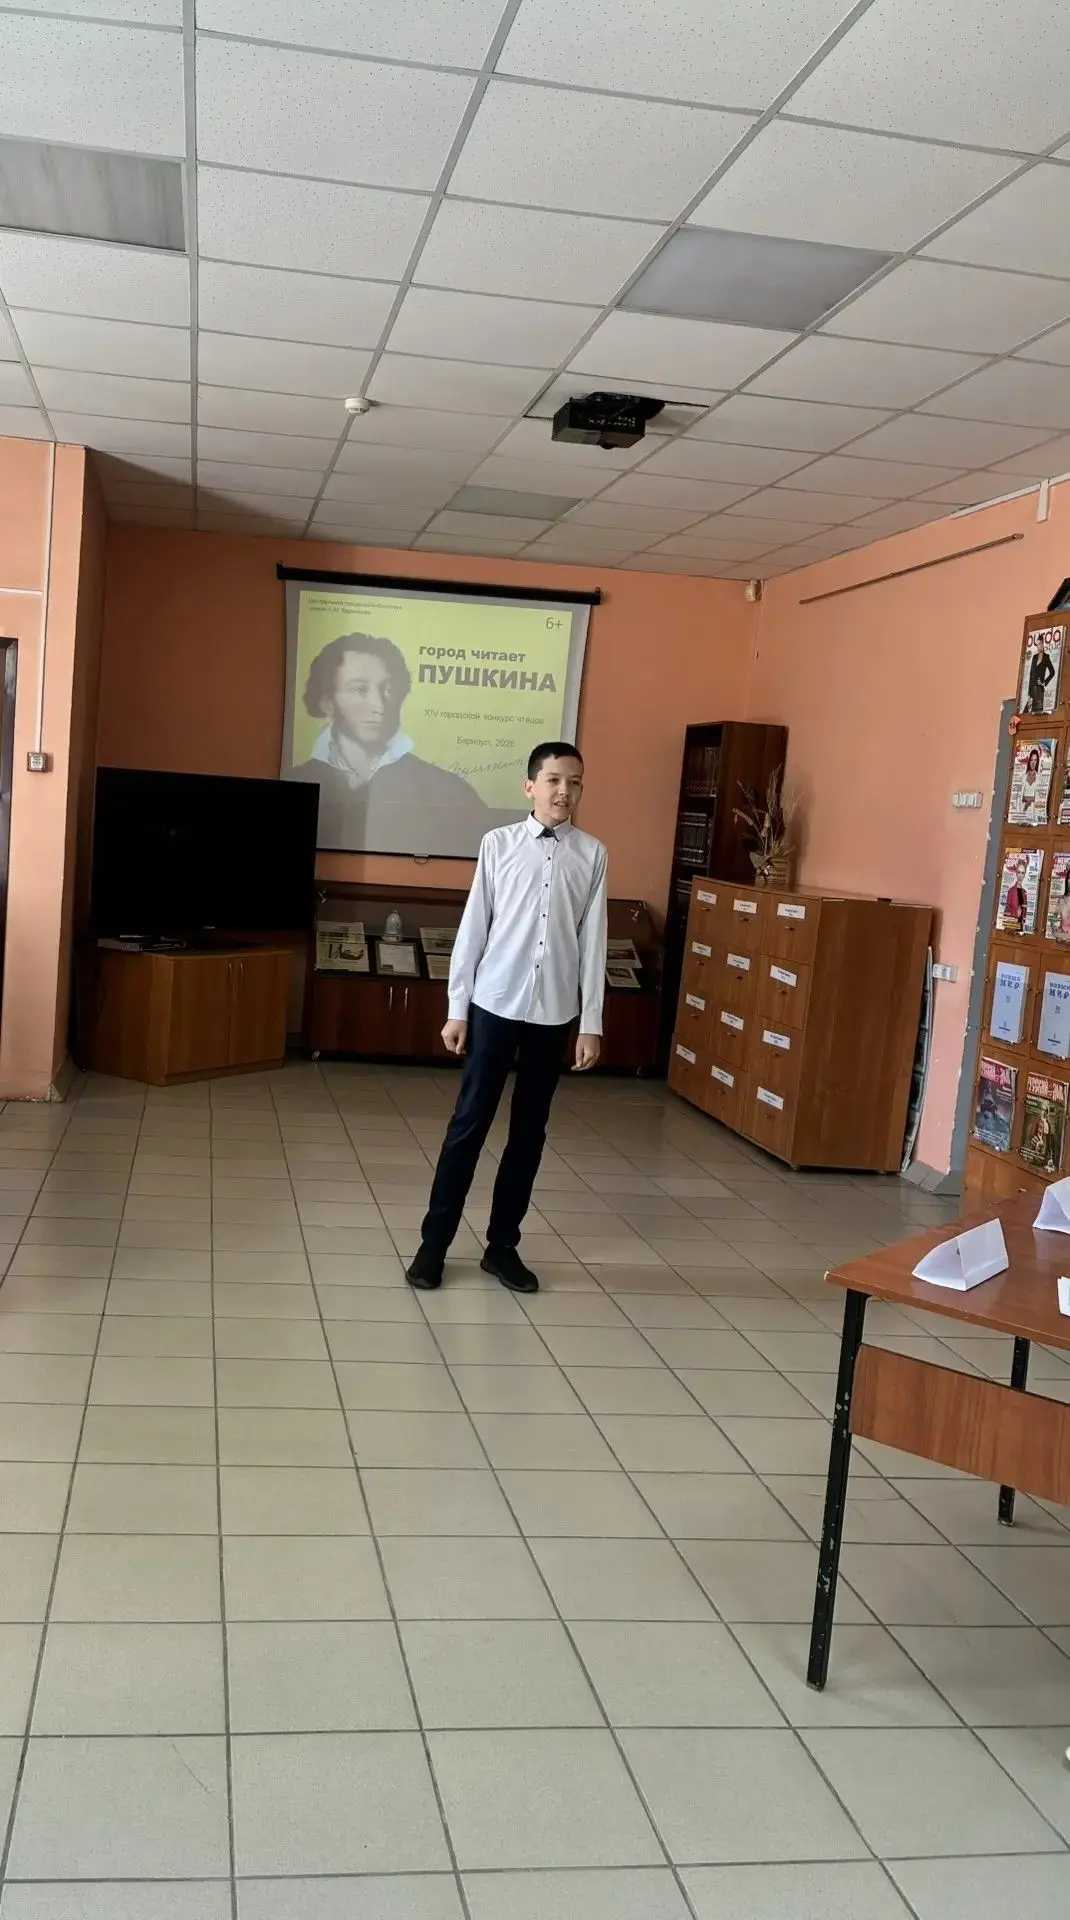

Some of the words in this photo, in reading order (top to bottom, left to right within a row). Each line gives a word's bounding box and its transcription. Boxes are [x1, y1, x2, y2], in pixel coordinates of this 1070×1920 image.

[546, 616, 563, 630] 6+
[419, 645, 466, 660] город
[471, 649, 526, 663] читает
[418, 663, 557, 693] ПУШКИНА
[440, 710, 480, 721] городской
[484, 713, 514, 724] конкурс
